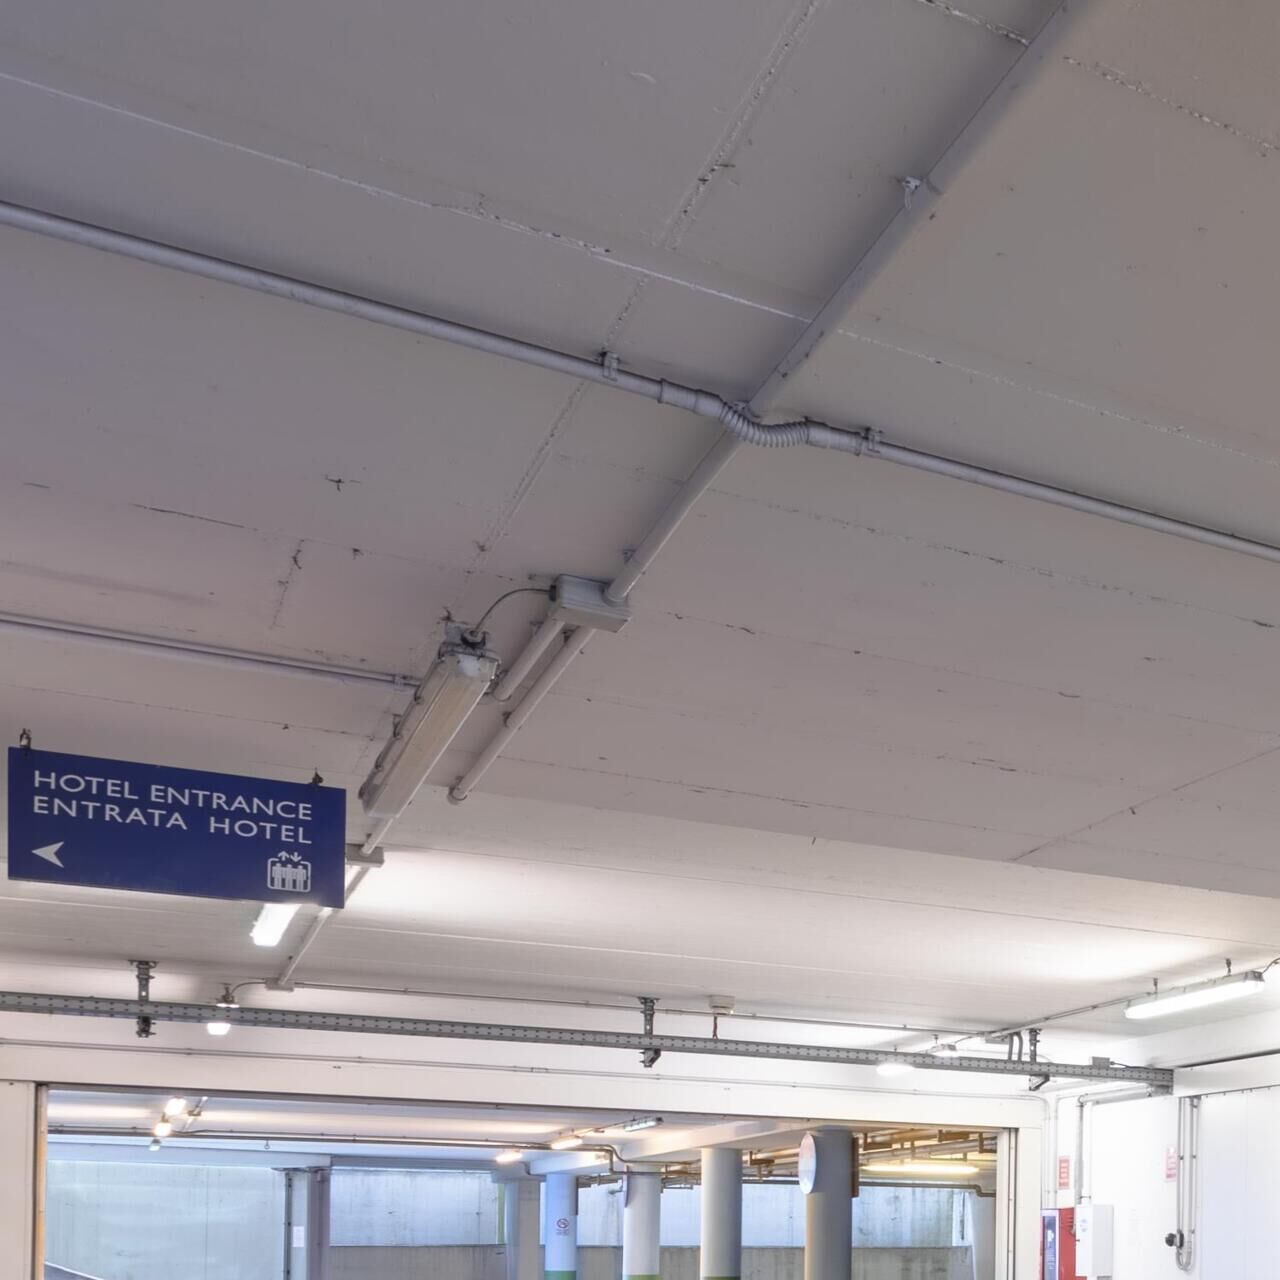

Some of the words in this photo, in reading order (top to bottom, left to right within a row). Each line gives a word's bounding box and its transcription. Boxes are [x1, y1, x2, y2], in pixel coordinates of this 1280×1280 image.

[33, 770, 138, 799] HOTEL
[151, 785, 312, 820] ENTRANCE
[33, 796, 187, 830] ENTRATA
[209, 816, 312, 843] HOTEL
